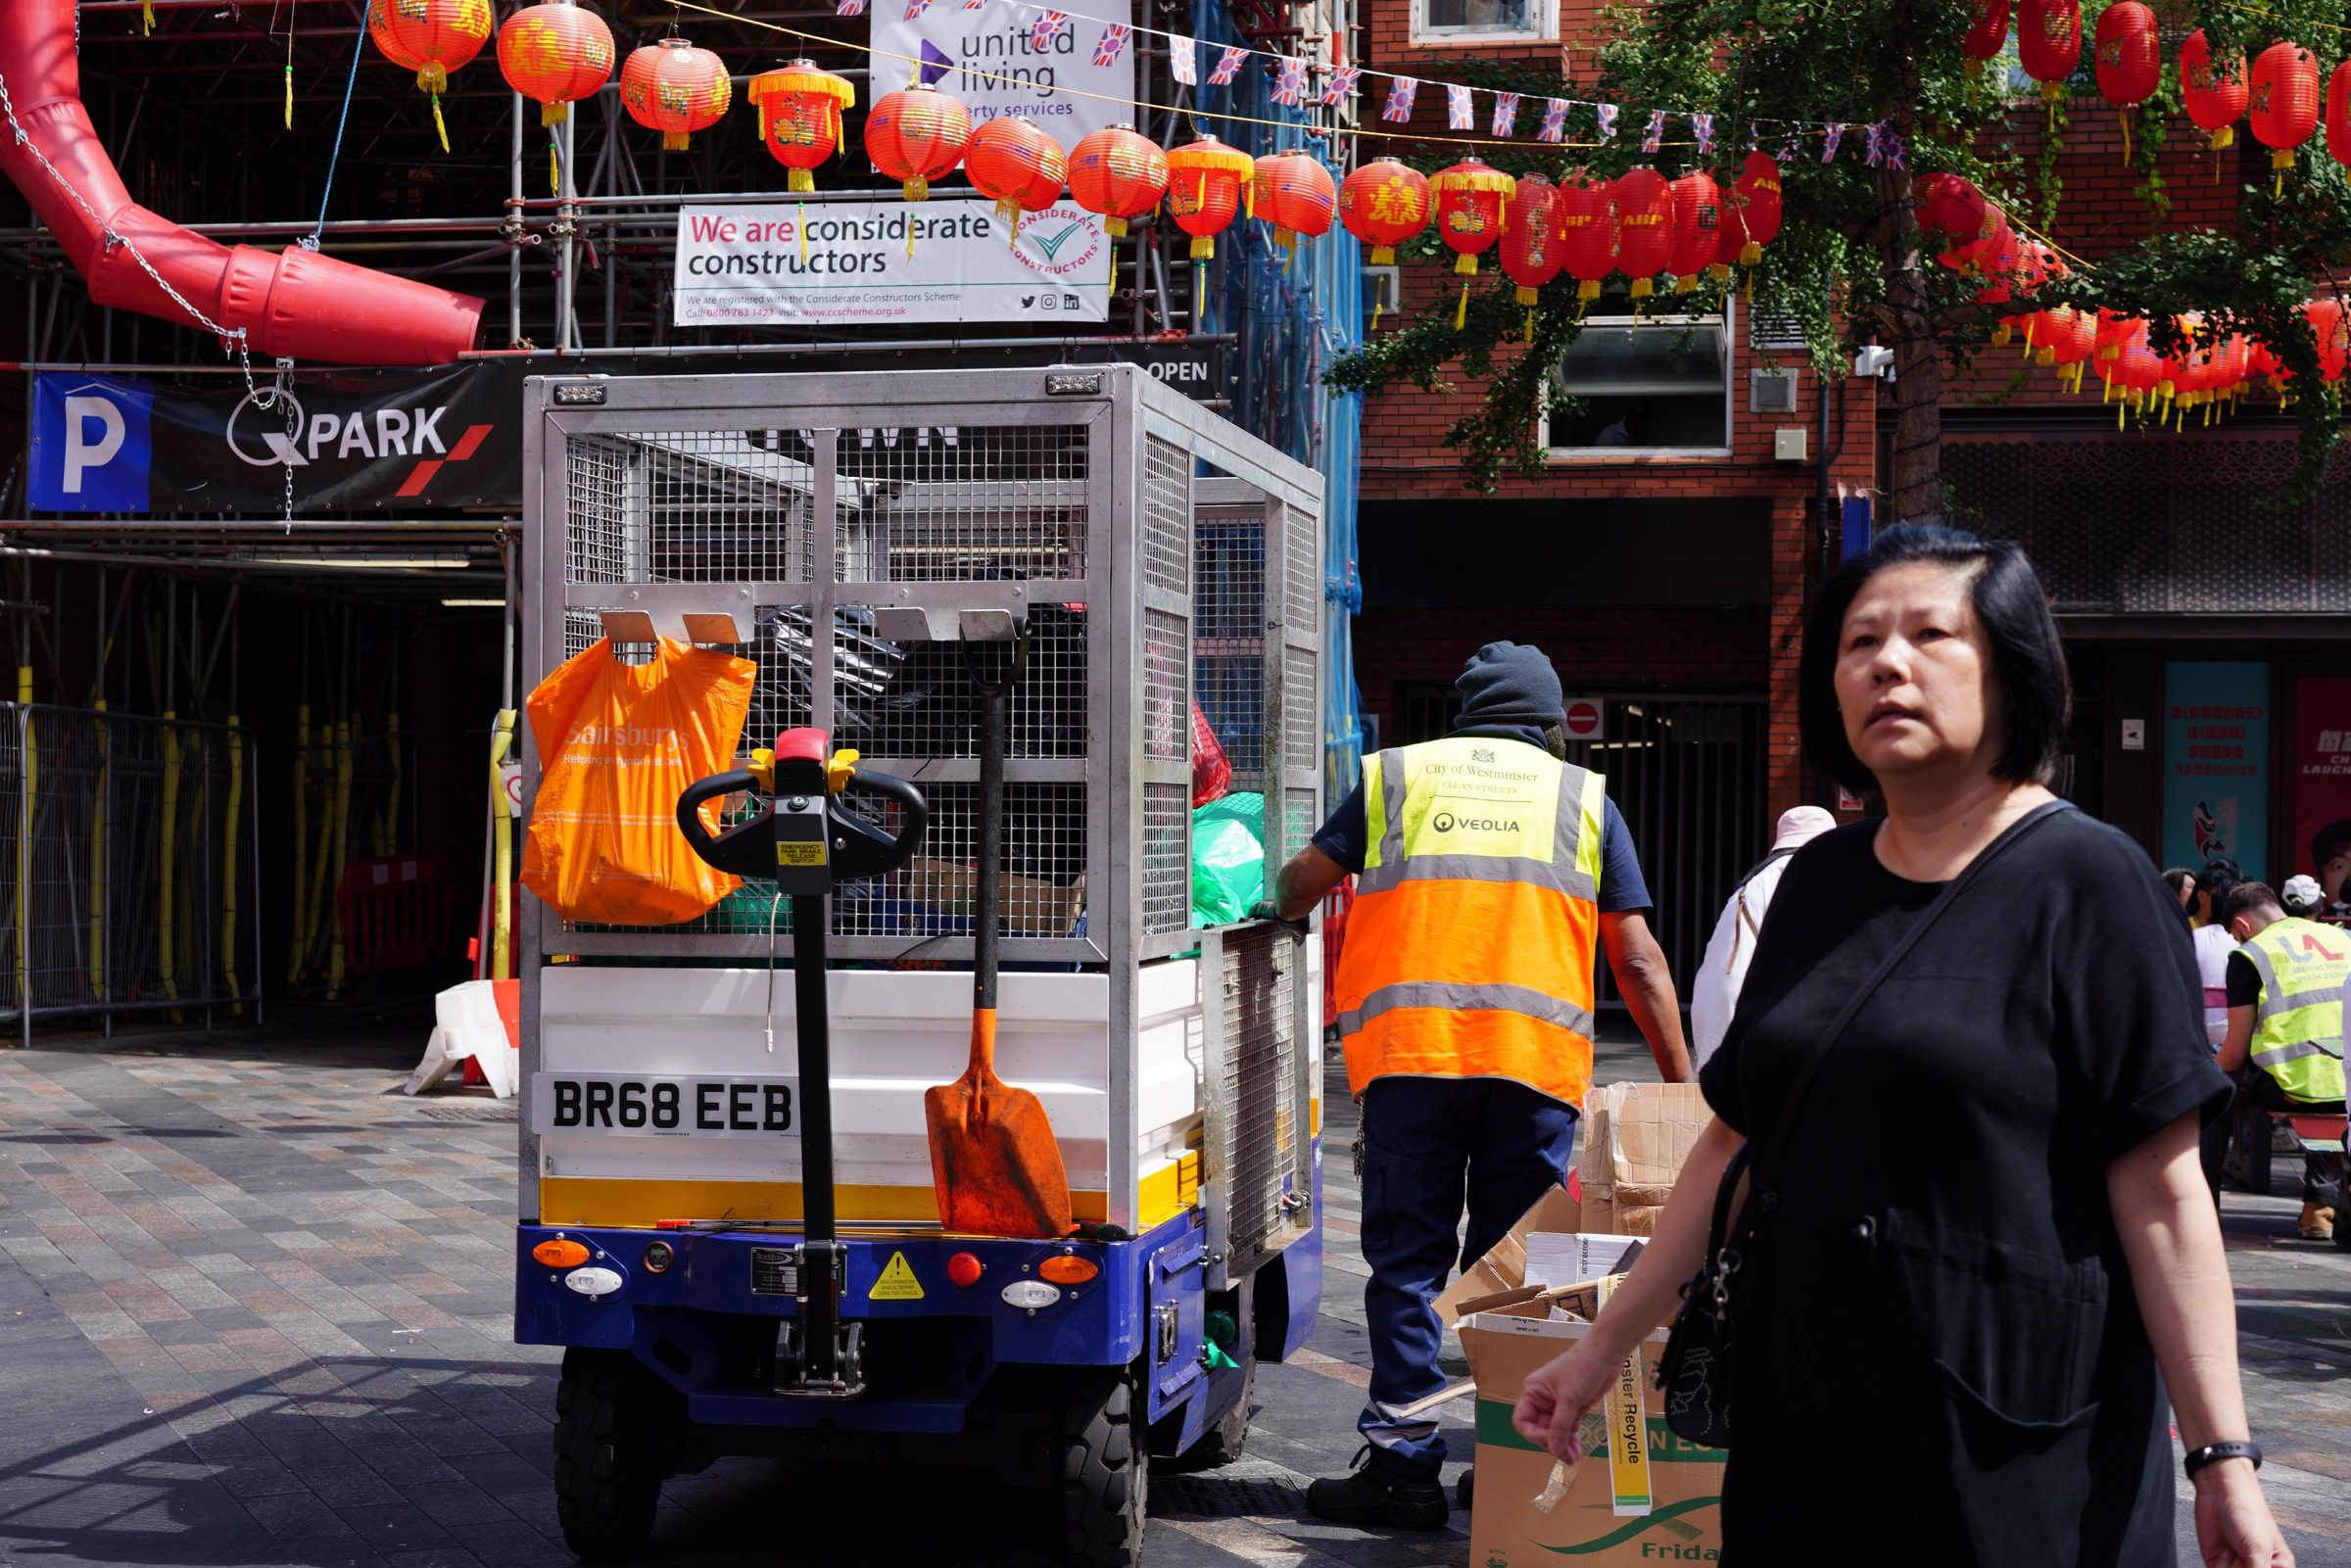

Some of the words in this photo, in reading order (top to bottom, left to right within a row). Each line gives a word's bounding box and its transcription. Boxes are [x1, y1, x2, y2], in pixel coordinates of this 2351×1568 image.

[962, 24, 1075, 58] unitd
[962, 61, 1054, 97] living
[1004, 103, 1074, 118] services
[691, 215, 737, 243] We
[745, 219, 794, 243] are
[805, 212, 990, 241] considerate
[1013, 209, 1100, 239] ONSIDERATE
[689, 249, 887, 275] constructors
[686, 296, 701, 305] We
[719, 295, 764, 306] registered
[766, 295, 788, 304] with
[789, 295, 804, 304] the
[806, 294, 861, 304] Considerate
[863, 294, 922, 303] Constructors
[924, 293, 961, 302] Scheme
[686, 309, 705, 318] Call:
[706, 309, 731, 317] 0800
[732, 309, 749, 317] 783
[752, 308, 774, 316] 1423
[778, 308, 798, 317] visit:
[801, 307, 906, 318] www.ccscheme.org.uk
[1148, 361, 1208, 382] OPEN
[63, 396, 126, 494] P
[563, 754, 602, 767] Helping
[1425, 764, 1449, 776] City
[1451, 765, 1464, 775] of
[1466, 765, 1539, 782] Westminster
[1442, 781, 1473, 790] CLEAN
[1475, 784, 1518, 794] STREETS
[1458, 818, 1520, 832] VEOLIA
[553, 1081, 680, 1128] BR68
[696, 1083, 792, 1131] EEB
[756, 1252, 786, 1261] Bradshaw
[1622, 1402, 1639, 1464] Recycle
